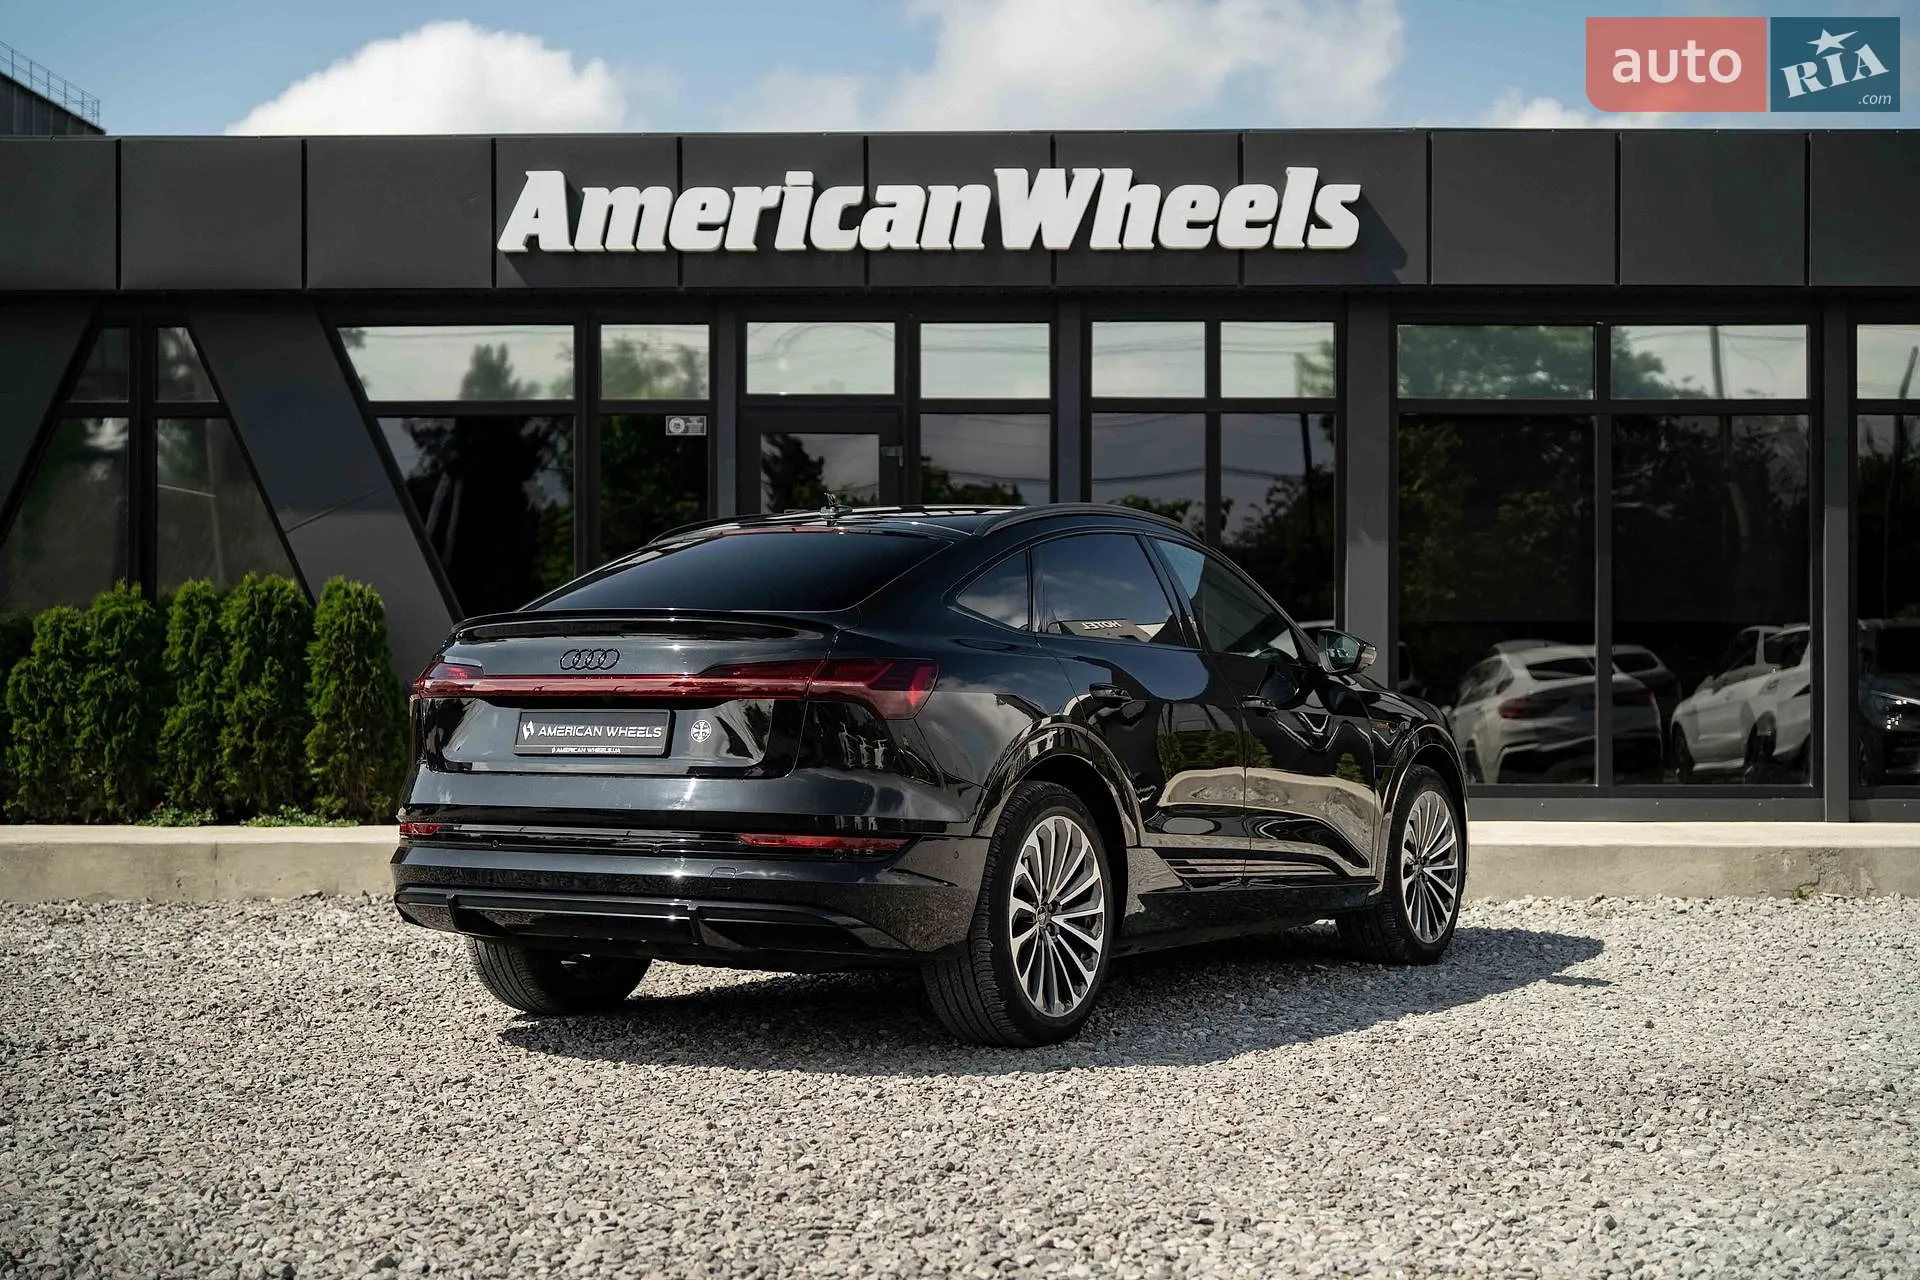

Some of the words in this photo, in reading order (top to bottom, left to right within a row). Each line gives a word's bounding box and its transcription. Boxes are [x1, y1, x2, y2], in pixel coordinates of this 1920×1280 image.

[496, 166, 1361, 252] AmericanWheels
[538, 726, 603, 737] AMERICAN
[606, 726, 661, 739] WHEELS
